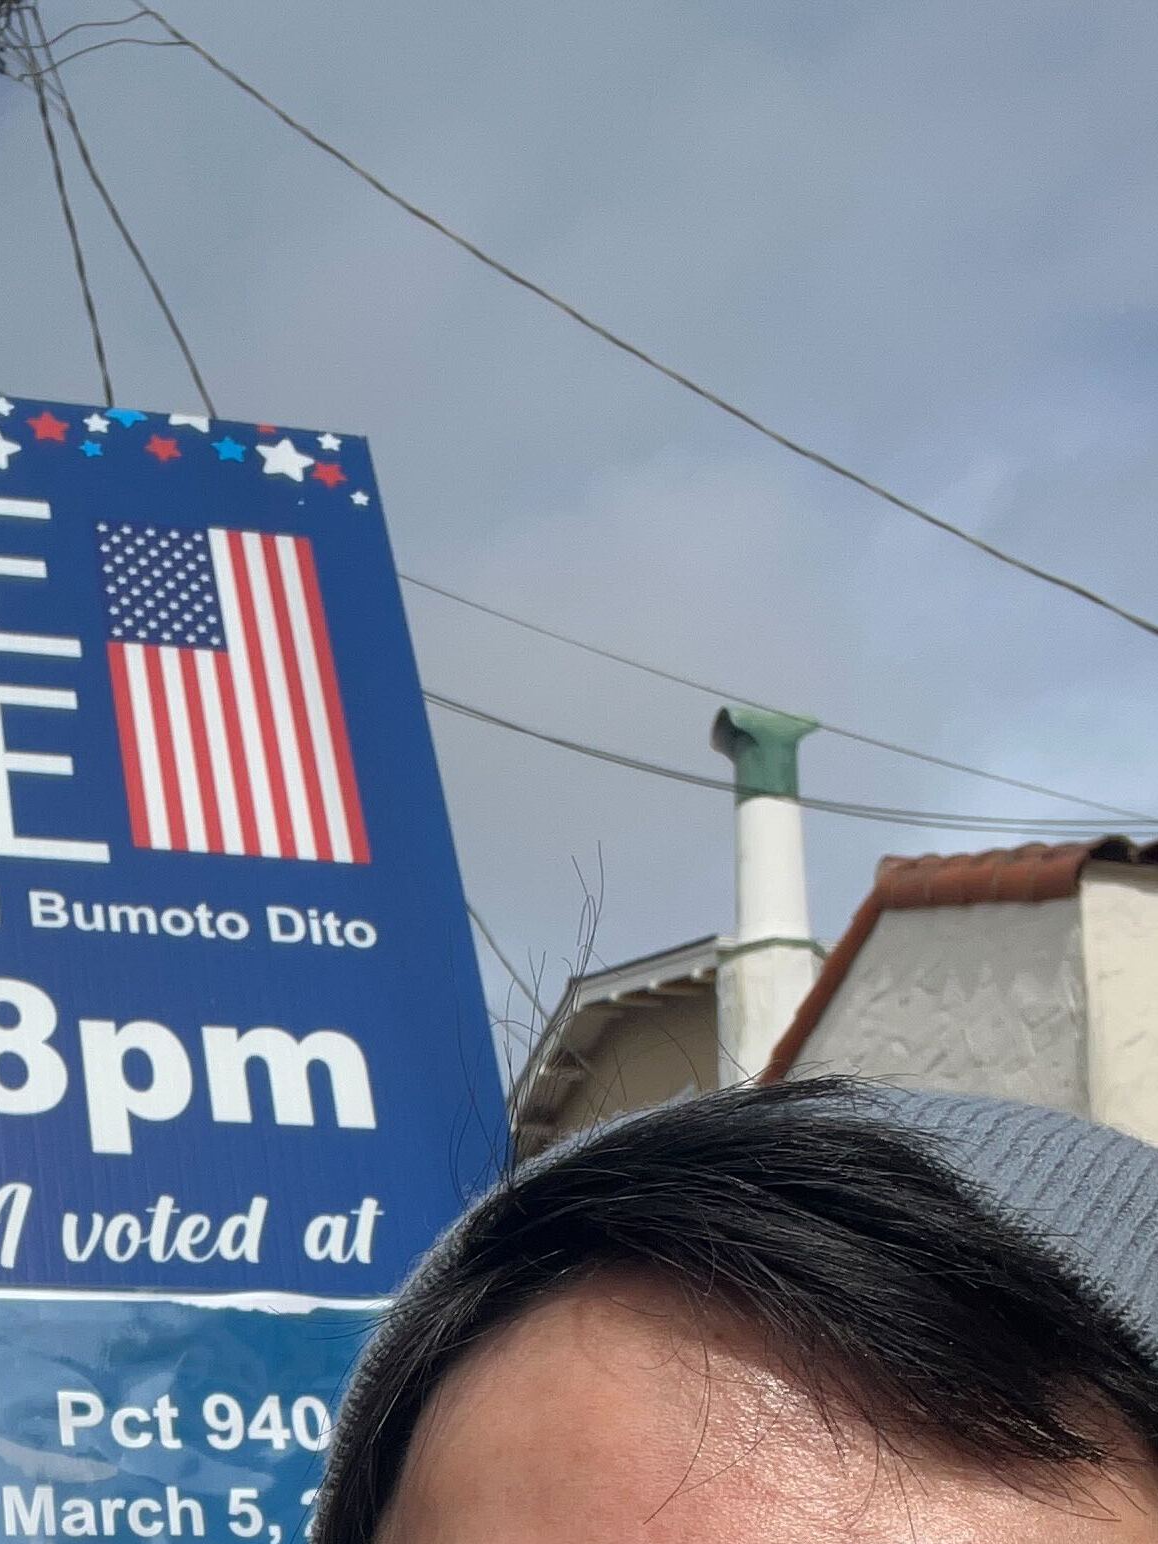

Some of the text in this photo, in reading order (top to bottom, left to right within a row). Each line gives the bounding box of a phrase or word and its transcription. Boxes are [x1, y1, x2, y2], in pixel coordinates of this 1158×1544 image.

[29, 889, 377, 948] Bumoto Dito
[62, 1196, 268, 1263] voted
[303, 1197, 384, 1263] at
[57, 1390, 182, 1449] Pct
[2, 1485, 205, 1537] March
